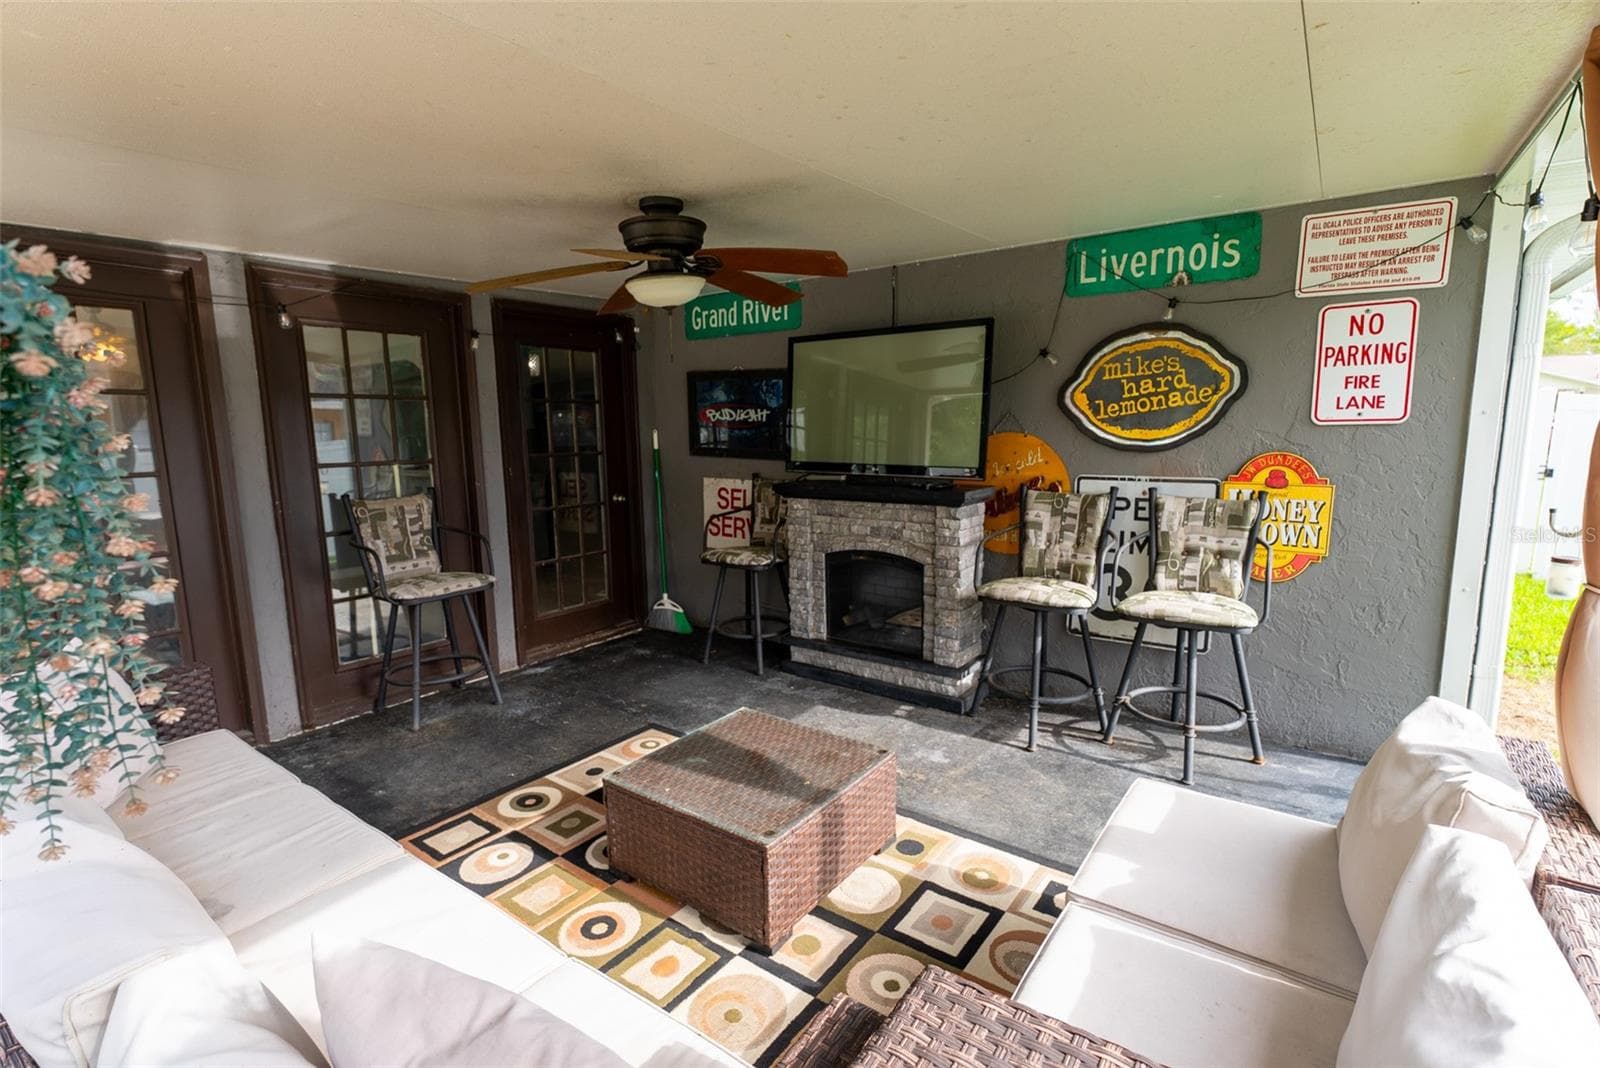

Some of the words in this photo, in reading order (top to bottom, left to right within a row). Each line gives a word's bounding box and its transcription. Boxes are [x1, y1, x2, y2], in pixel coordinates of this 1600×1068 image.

[1312, 222, 1321, 230] ALL
[1323, 220, 1341, 229] OCALA
[1343, 217, 1362, 227] POLICE
[1364, 214, 1392, 224] OFFICERS
[1393, 212, 1405, 220] ARE
[1406, 208, 1444, 218] AUTHORIZED
[1312, 226, 1361, 239] REPRESENTATIVES
[1364, 225, 1371, 233] TO
[1372, 222, 1393, 232] ADVISE
[1394, 221, 1407, 230] ANY
[1408, 219, 1433, 228] PERSON
[1339, 237, 1357, 246] LEAVE
[1358, 234, 1375, 243] THESE
[1377, 231, 1408, 241] PREMISES.
[1079, 233, 1241, 284] Livernois
[1308, 255, 1330, 264] FAILURE
[1340, 252, 1357, 260] LEAVE
[1358, 251, 1369, 259] THE
[1370, 247, 1400, 257] PREMISES
[1402, 245, 1420, 254] AFTER
[1422, 244, 1440, 253] BEING
[1310, 263, 1343, 272] INSTRUCTED
[1344, 262, 1357, 270] MAY
[1358, 258, 1380, 269] RESULT
[1388, 257, 1397, 265] AN
[1398, 255, 1422, 264] ARREST
[1423, 254, 1435, 263] FOR
[1331, 270, 1359, 280] TRESPASS
[1360, 268, 1379, 277] AFTER
[692, 300, 737, 331] Grand
[743, 300, 788, 325] River
[1349, 313, 1384, 336] NO
[1324, 342, 1407, 367] PARKING
[1102, 355, 1181, 380] mike's
[1121, 369, 1190, 398] hard
[1344, 374, 1381, 389] FIRE
[1095, 384, 1213, 419] lemonade
[1336, 395, 1386, 410] LANE
[717, 487, 747, 510] SEL
